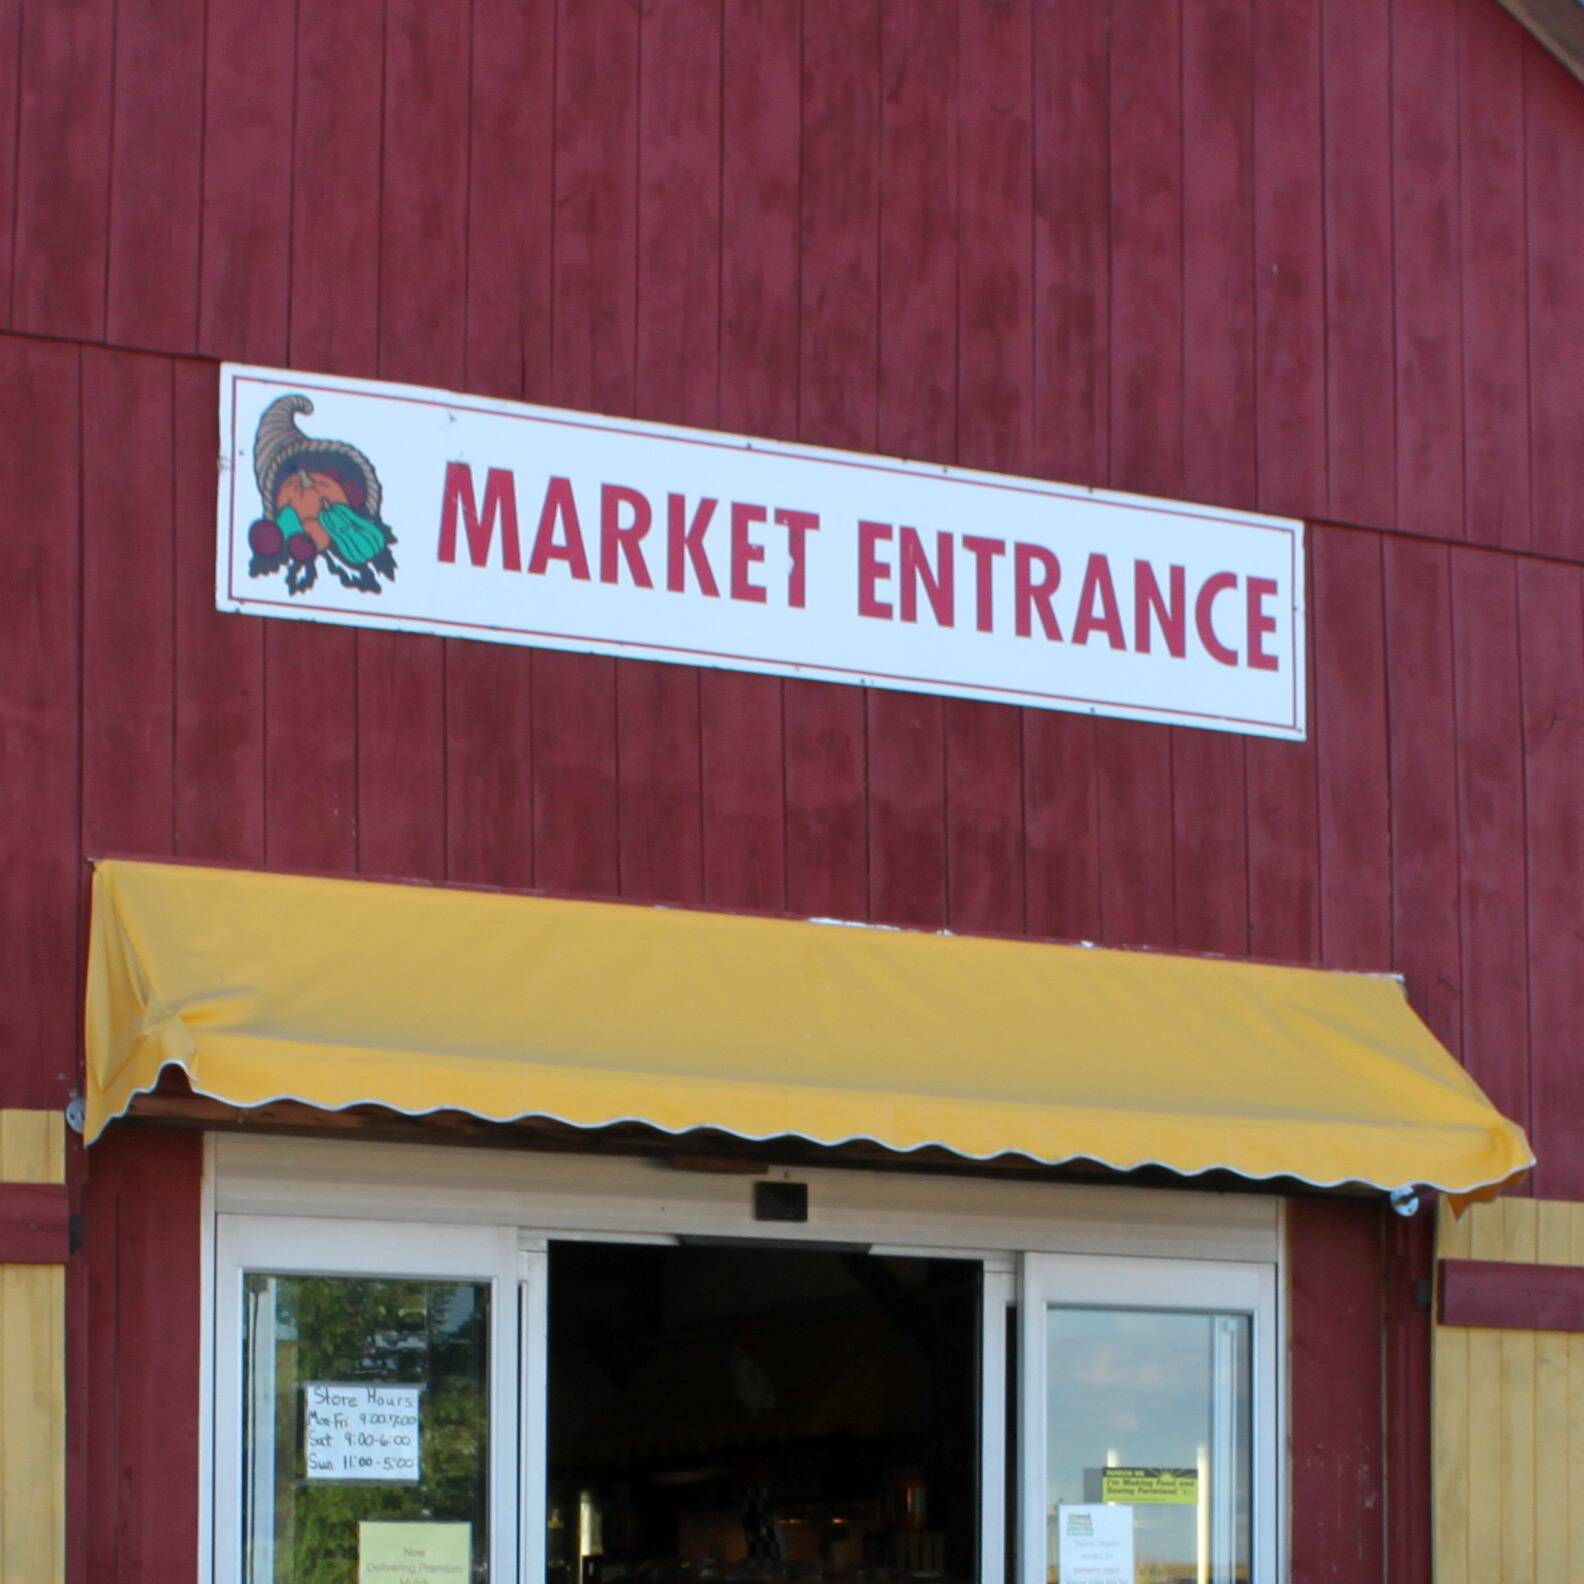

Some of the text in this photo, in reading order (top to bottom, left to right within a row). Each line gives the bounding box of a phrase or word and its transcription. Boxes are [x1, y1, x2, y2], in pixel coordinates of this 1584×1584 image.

[437, 460, 1279, 672] MARKET ENTRANCE
[313, 1386, 414, 1408] Store Hours
[309, 1430, 333, 1447] Sat
[309, 1453, 333, 1470] Sun
[366, 1562, 464, 1575] Delivering Premium
